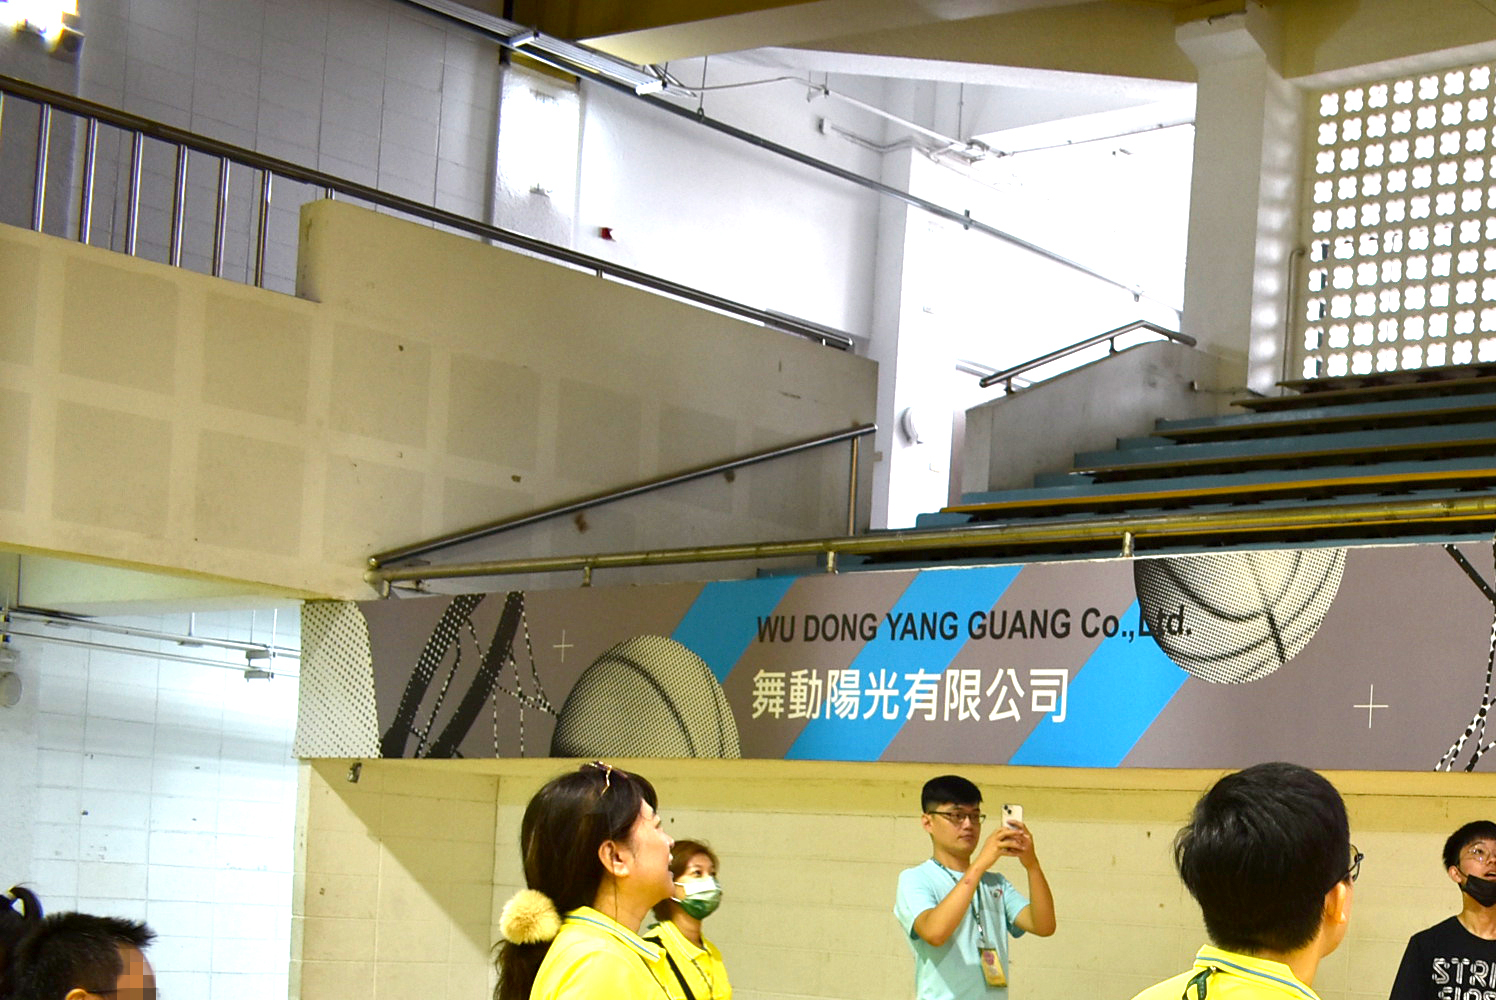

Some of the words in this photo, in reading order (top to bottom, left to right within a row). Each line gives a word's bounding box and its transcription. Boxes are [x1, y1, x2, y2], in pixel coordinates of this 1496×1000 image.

[757, 615, 796, 643] WU
[803, 612, 878, 642] DONG
[886, 611, 958, 641] YANG
[968, 608, 1071, 640] GUANG
[752, 668, 1070, 722] 舞動陽光有限公司
